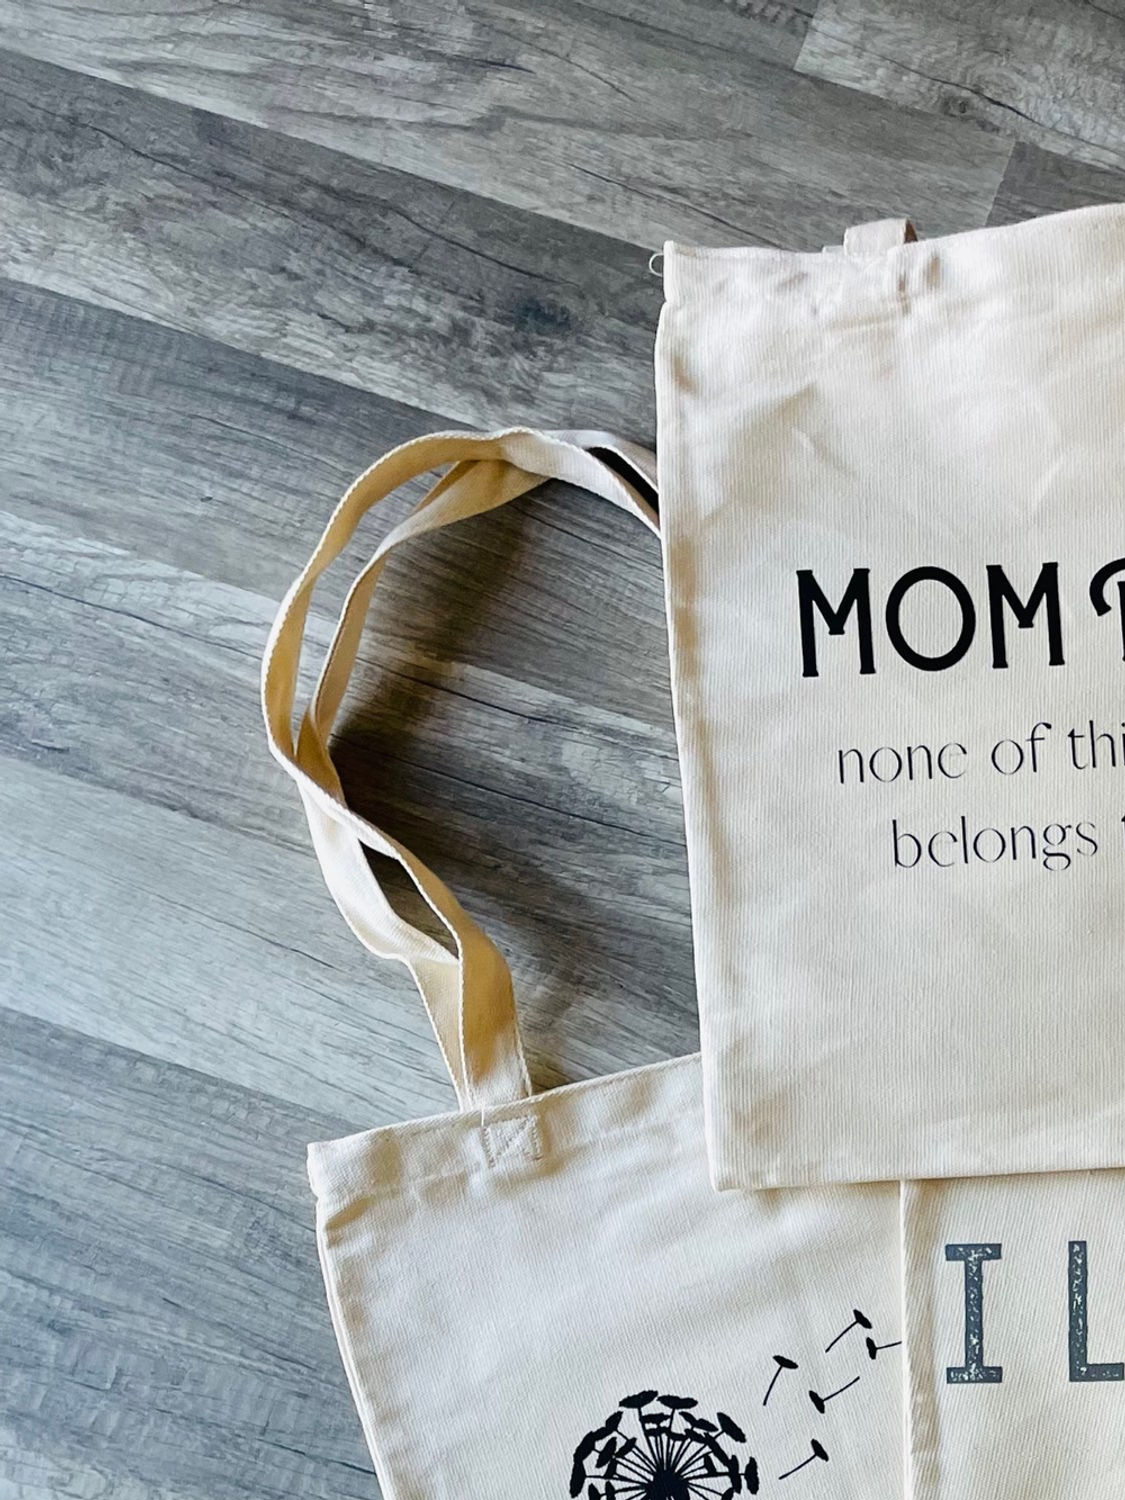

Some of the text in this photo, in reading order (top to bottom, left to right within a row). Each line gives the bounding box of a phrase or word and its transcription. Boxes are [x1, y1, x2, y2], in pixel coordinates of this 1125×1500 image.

[796, 562, 1065, 678] MOM
[838, 742, 968, 784] none
[990, 722, 1052, 776] of
[892, 815, 1099, 871] belongs
[945, 1243, 1003, 1384] I
